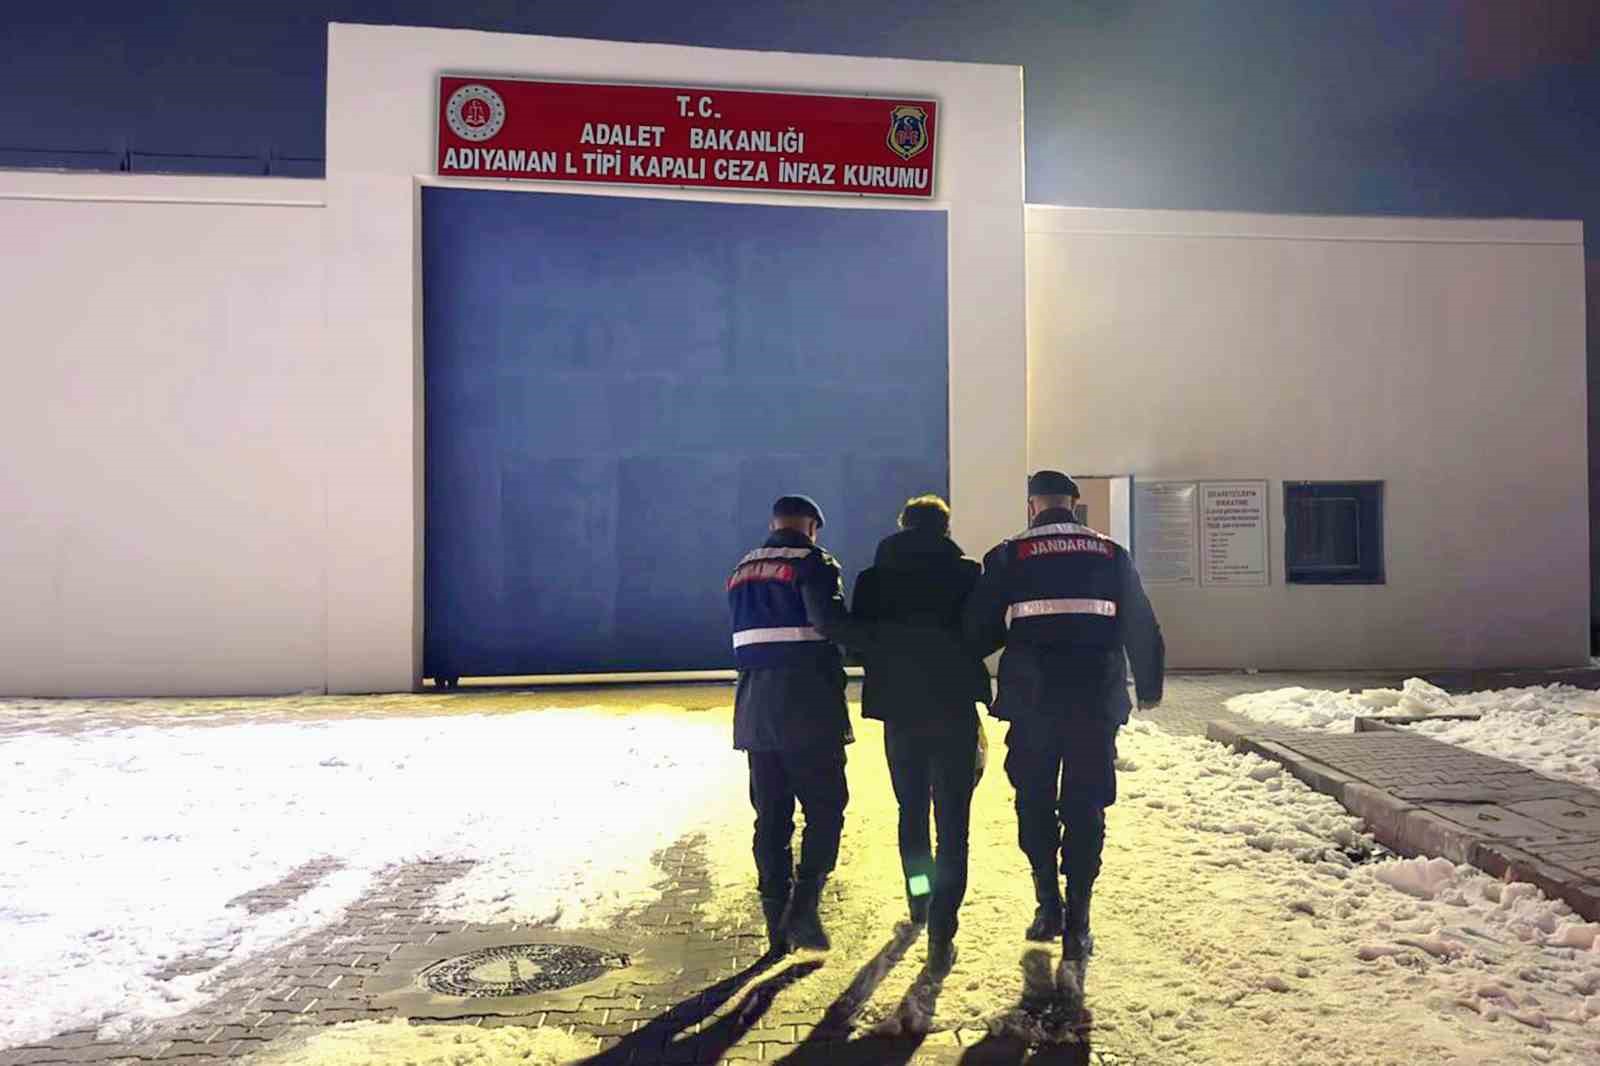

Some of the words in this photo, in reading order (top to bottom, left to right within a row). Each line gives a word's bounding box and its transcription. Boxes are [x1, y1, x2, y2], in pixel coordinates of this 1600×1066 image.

[580, 123, 665, 147] ADALET
[689, 126, 805, 154] BAKANLIĞI
[443, 147, 557, 173] ADIYAMAN
[565, 152, 577, 174] L
[582, 148, 622, 176] TİPİ
[629, 154, 706, 180] KAPALI
[714, 159, 769, 182] CEZA
[778, 157, 835, 184] İNFAZ
[843, 164, 929, 189] KURUMU
[1030, 537, 1108, 556] JANDARMA
